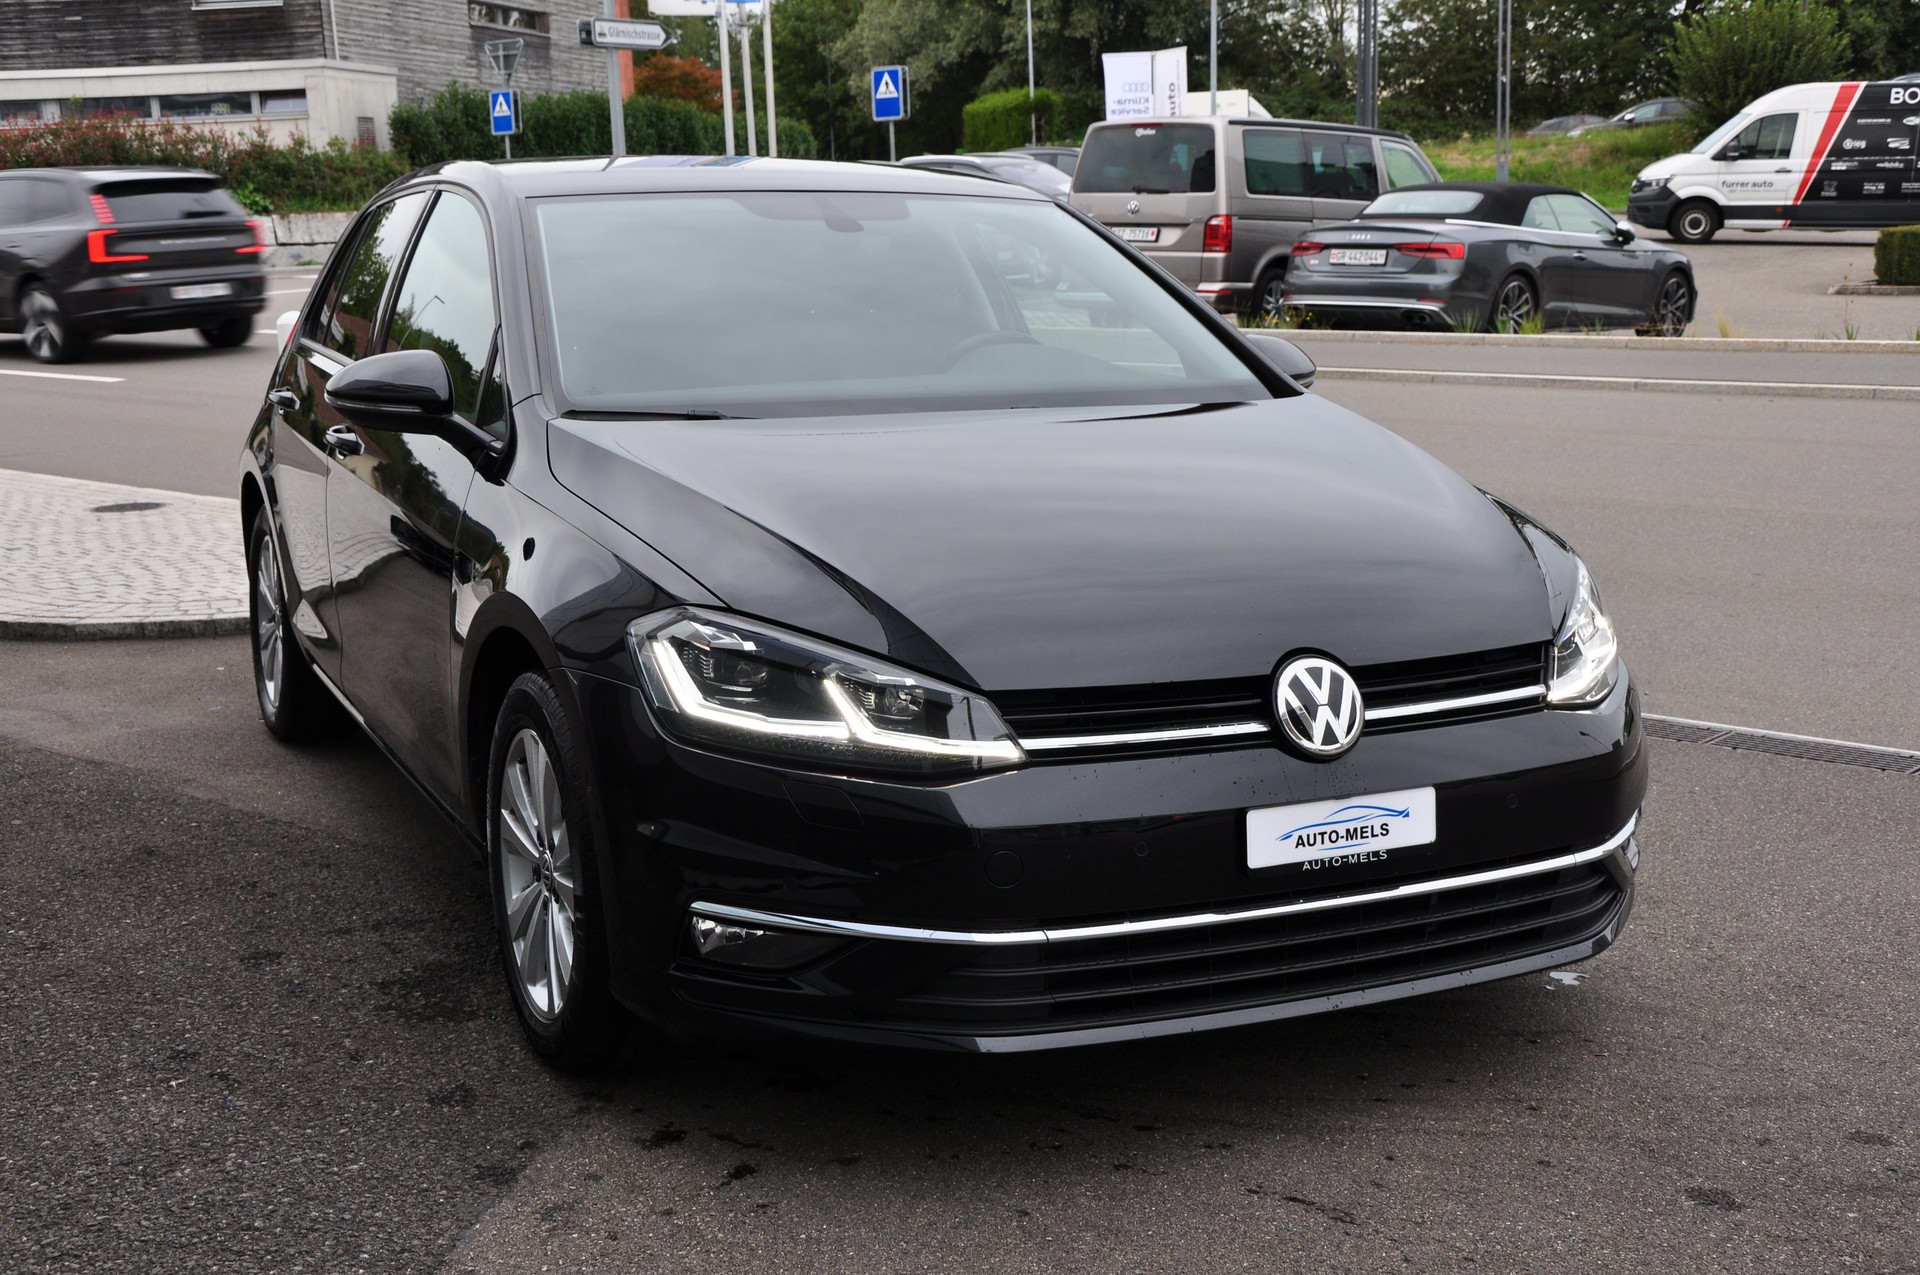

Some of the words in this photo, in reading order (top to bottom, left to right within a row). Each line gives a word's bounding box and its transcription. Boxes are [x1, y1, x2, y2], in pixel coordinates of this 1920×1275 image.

[608, 26, 660, 41] Glärnischstrasse
[1722, 180, 1749, 188] furrer
[1278, 658, 1363, 753] VW
[1295, 822, 1390, 849] AUTO-MELS
[1302, 850, 1388, 871] AUTO-MELS
